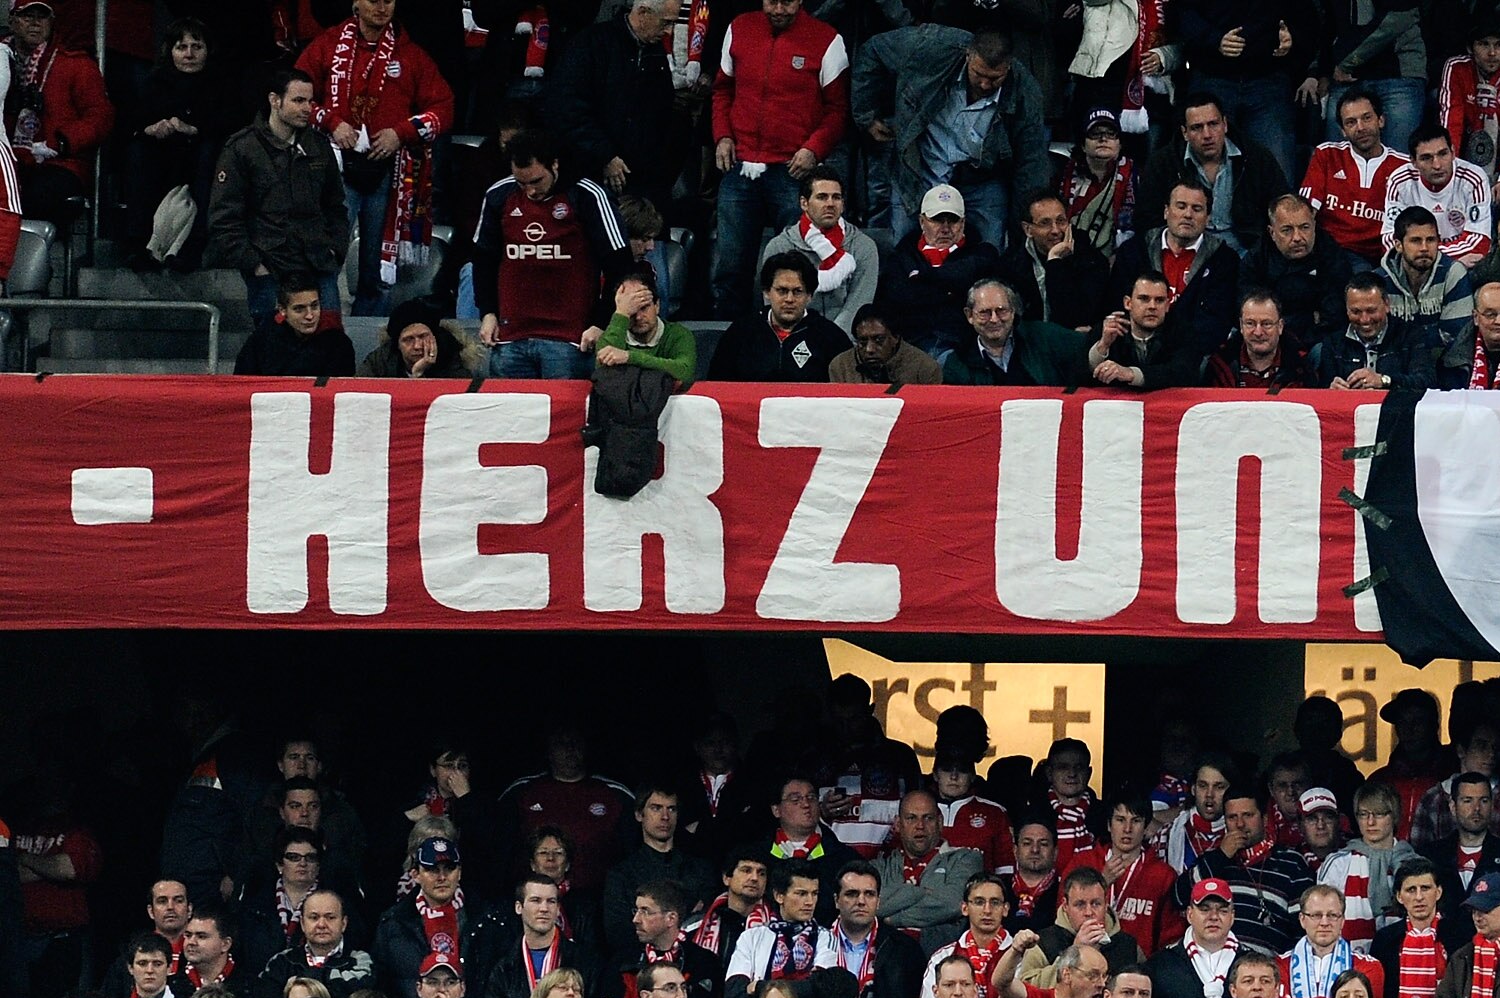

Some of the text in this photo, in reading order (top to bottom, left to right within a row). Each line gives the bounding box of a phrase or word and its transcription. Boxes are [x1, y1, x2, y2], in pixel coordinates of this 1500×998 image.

[506, 244, 571, 260] OPEL
[247, 392, 904, 622] HERZ
[995, 400, 1388, 632] UN
